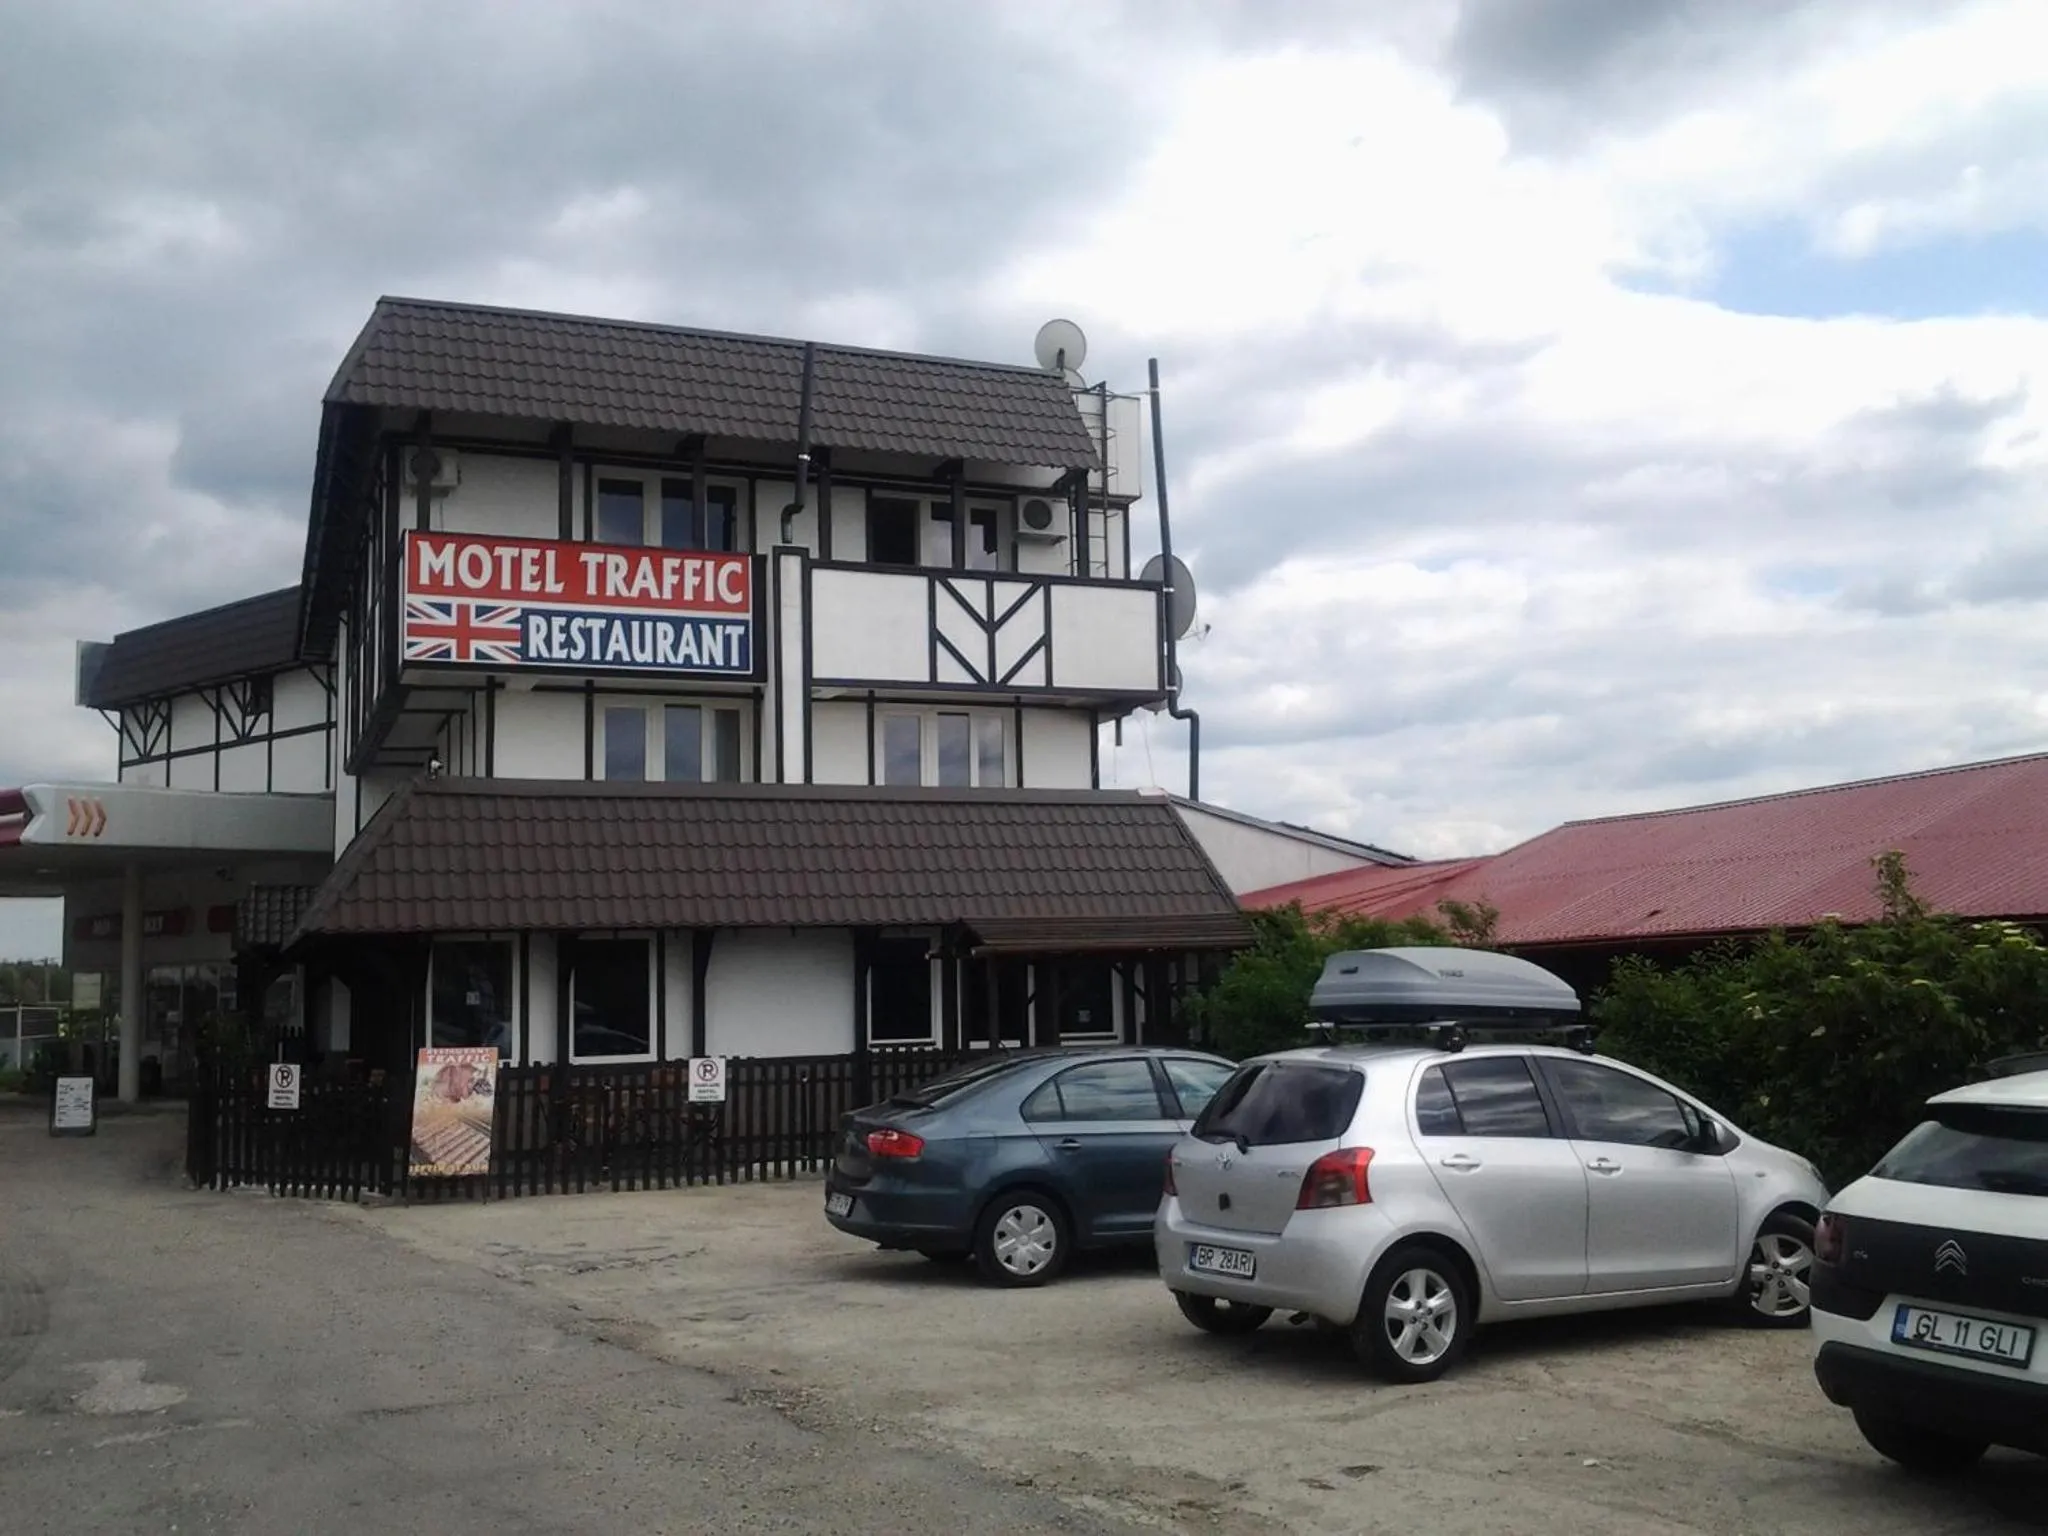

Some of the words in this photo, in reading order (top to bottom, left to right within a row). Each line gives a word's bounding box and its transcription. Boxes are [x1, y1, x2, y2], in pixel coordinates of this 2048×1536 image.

[416, 540, 565, 594] MOTEL
[579, 552, 744, 605] TRAFFIC
[527, 615, 746, 668] RESTAURANT
[1199, 1247, 1214, 1266] BR
[1914, 1314, 1942, 1341] GL
[1954, 1320, 1971, 1347] 11
[1980, 1326, 2018, 1356] GLI
